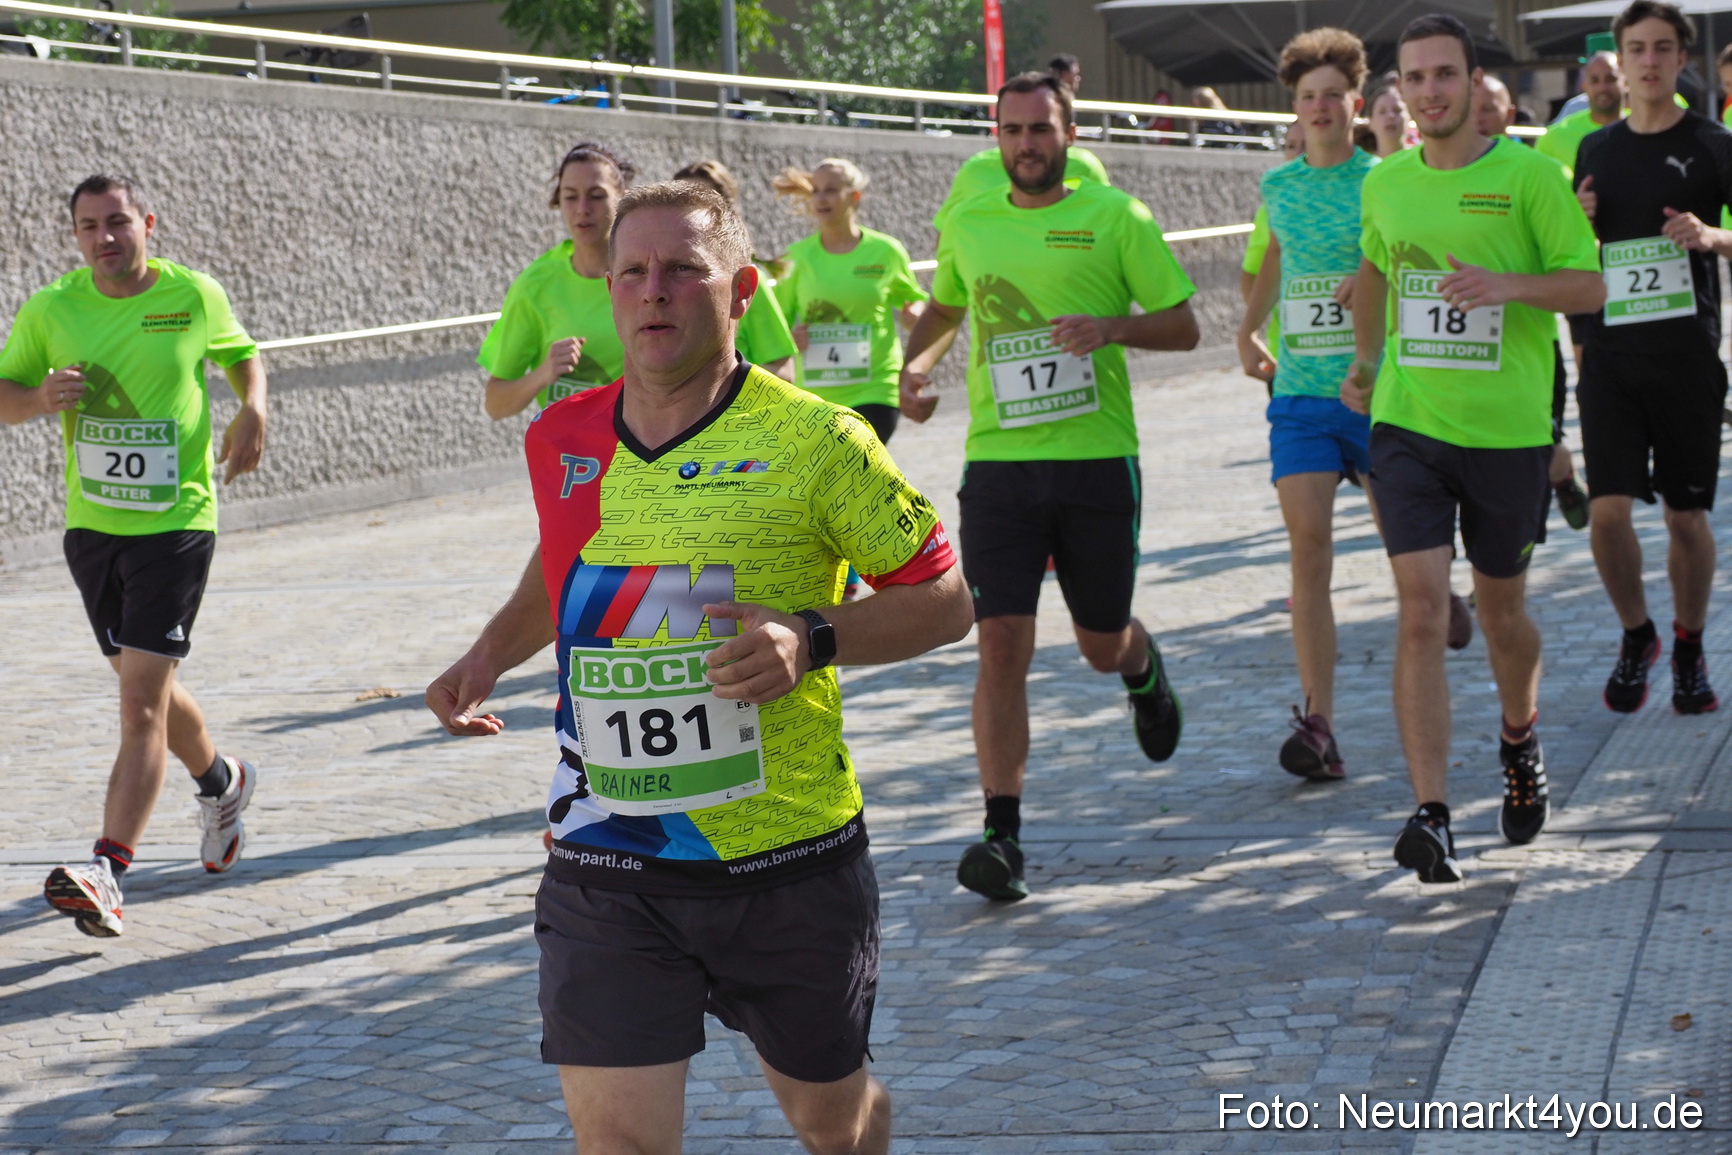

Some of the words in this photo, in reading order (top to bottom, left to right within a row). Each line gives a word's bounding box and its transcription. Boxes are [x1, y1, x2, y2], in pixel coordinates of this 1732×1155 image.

[1609, 241, 1675, 264] BOCK
[1289, 276, 1339, 296] BOC
[1627, 267, 1663, 293] 22
[1309, 302, 1344, 327] 23
[1625, 298, 1670, 314] LOUIS
[1427, 306, 1468, 335] 18
[994, 333, 1053, 358] BOC
[1296, 332, 1356, 348] HENDRI
[1406, 341, 1489, 358] CHRISTOPH
[828, 345, 840, 364] 4
[1021, 361, 1059, 392] 17
[1005, 389, 1087, 417] SEBASTIAN
[83, 421, 168, 444] BOCK
[105, 452, 146, 478] 20
[101, 484, 150, 500] PETER
[701, 480, 746, 490] NEUMARKT
[605, 703, 712, 758] 181
[600, 773, 672, 798] RAINER
[728, 822, 859, 876] www.bmw-partl.de
